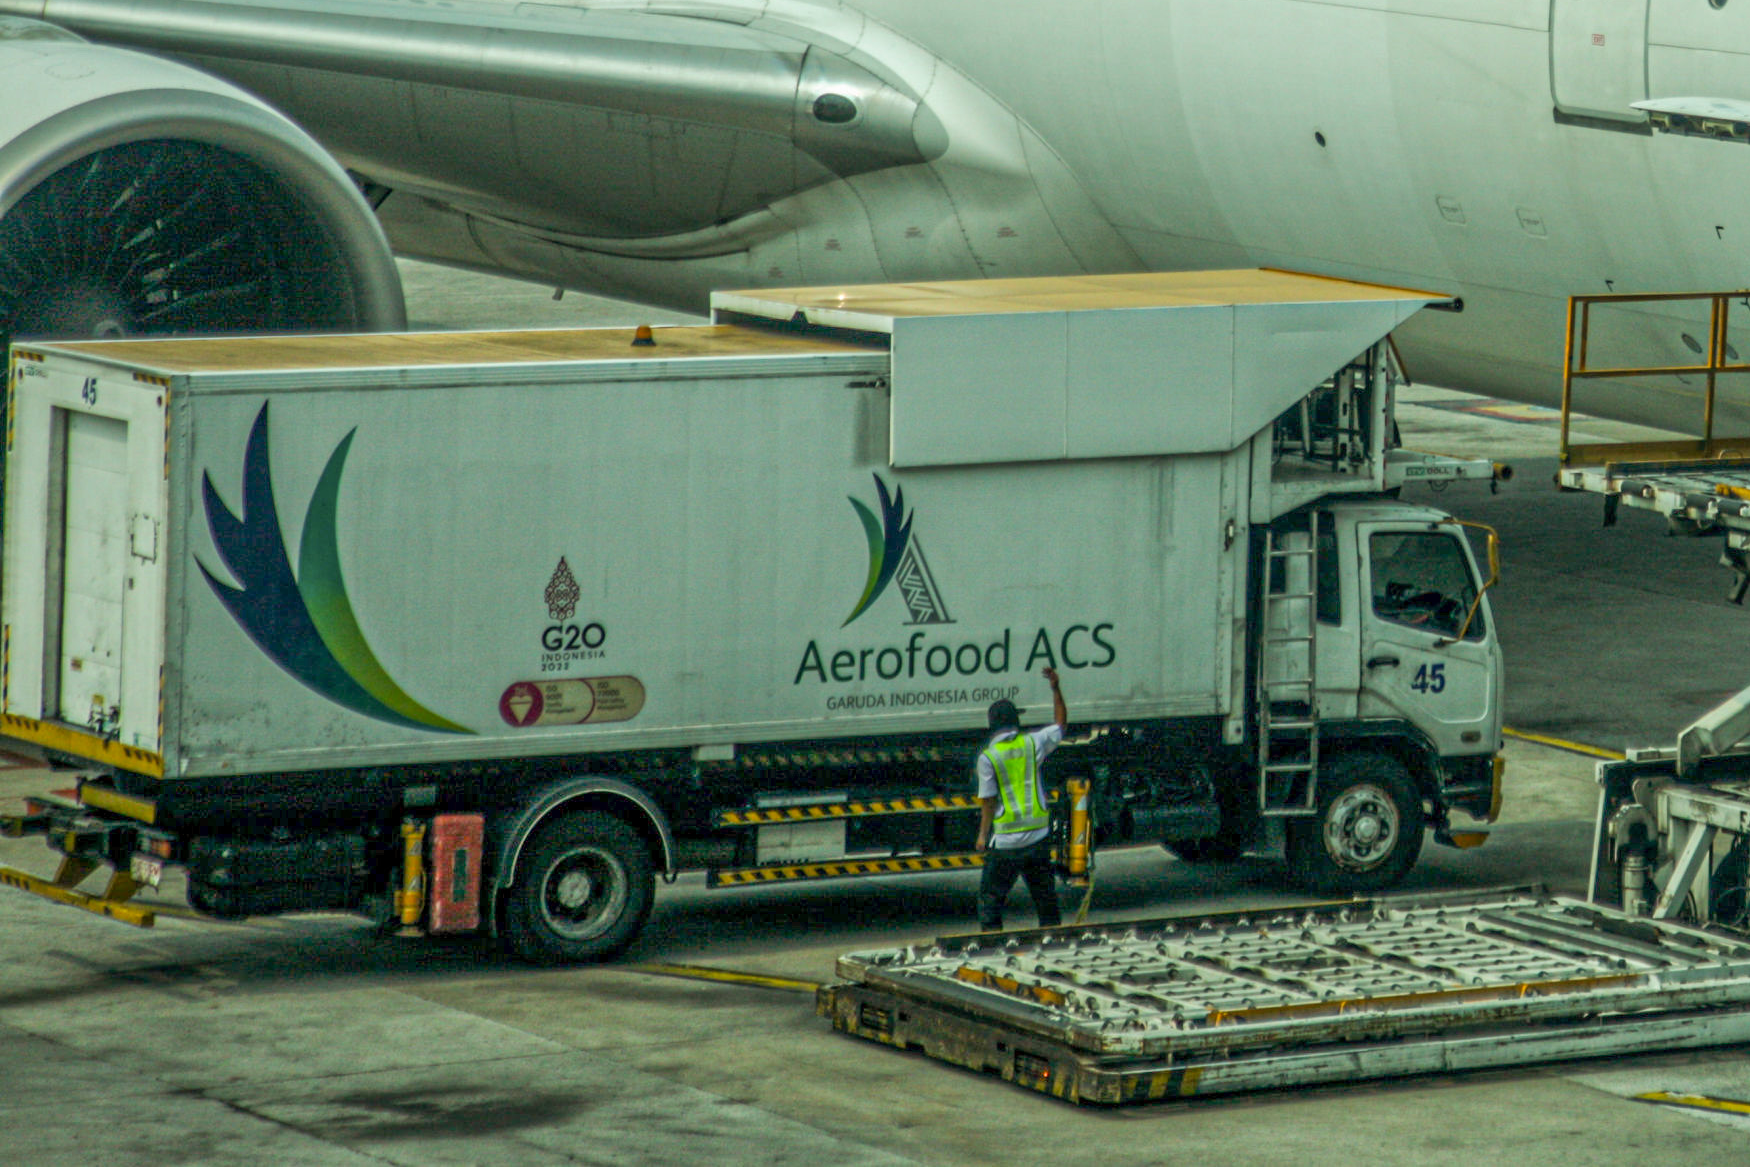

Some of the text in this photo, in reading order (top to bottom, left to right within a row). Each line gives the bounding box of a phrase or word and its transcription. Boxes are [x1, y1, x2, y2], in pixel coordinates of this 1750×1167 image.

[82, 377, 98, 406] 45
[541, 622, 606, 652] G20
[541, 651, 606, 663] INDONESIA
[541, 662, 570, 672] 2022
[794, 622, 1116, 685] Aerofood ACS
[1411, 663, 1445, 694] 45
[826, 685, 1020, 711] GARUDA INDONESIA GROUP
